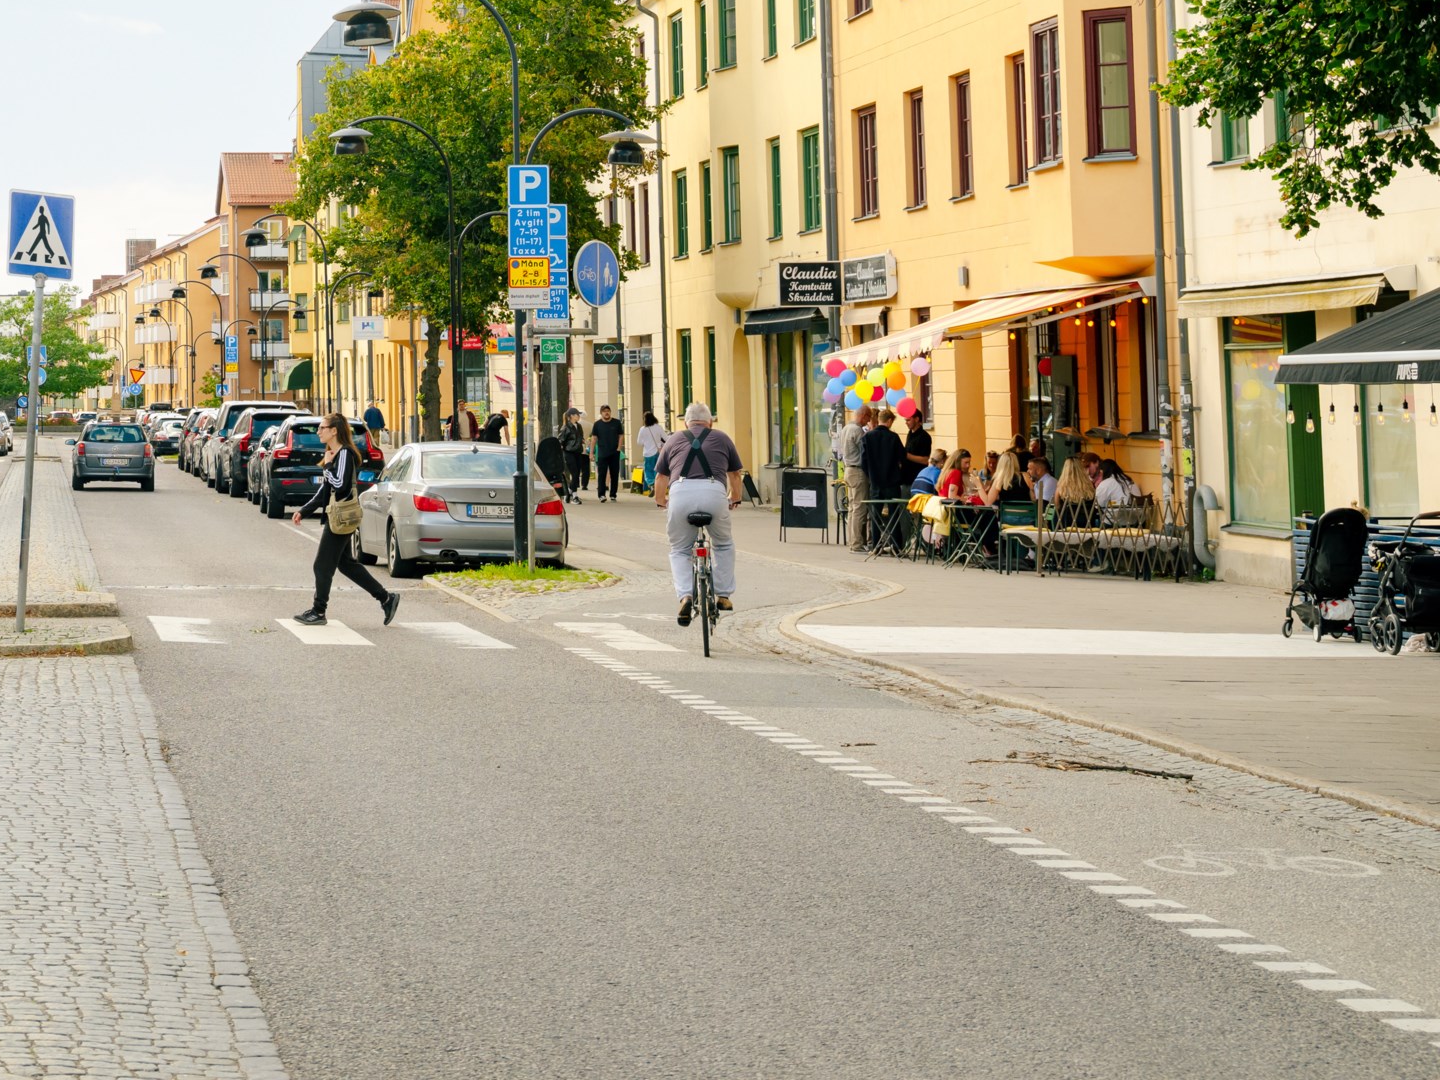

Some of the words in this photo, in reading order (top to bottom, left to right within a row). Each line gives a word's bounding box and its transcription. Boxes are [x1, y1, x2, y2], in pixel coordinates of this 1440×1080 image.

[519, 170, 541, 201] P
[526, 209, 541, 217] tim
[514, 219, 543, 227] Avgift
[519, 228, 539, 236] 7-19
[516, 237, 542, 246] (11-17)
[512, 247, 536, 255] Taxa
[539, 247, 545, 255] 4
[782, 266, 838, 280] Claudia
[788, 281, 833, 291] Kemtvätt
[787, 292, 834, 302] Skrädderi
[472, 506, 490, 515] UUL
